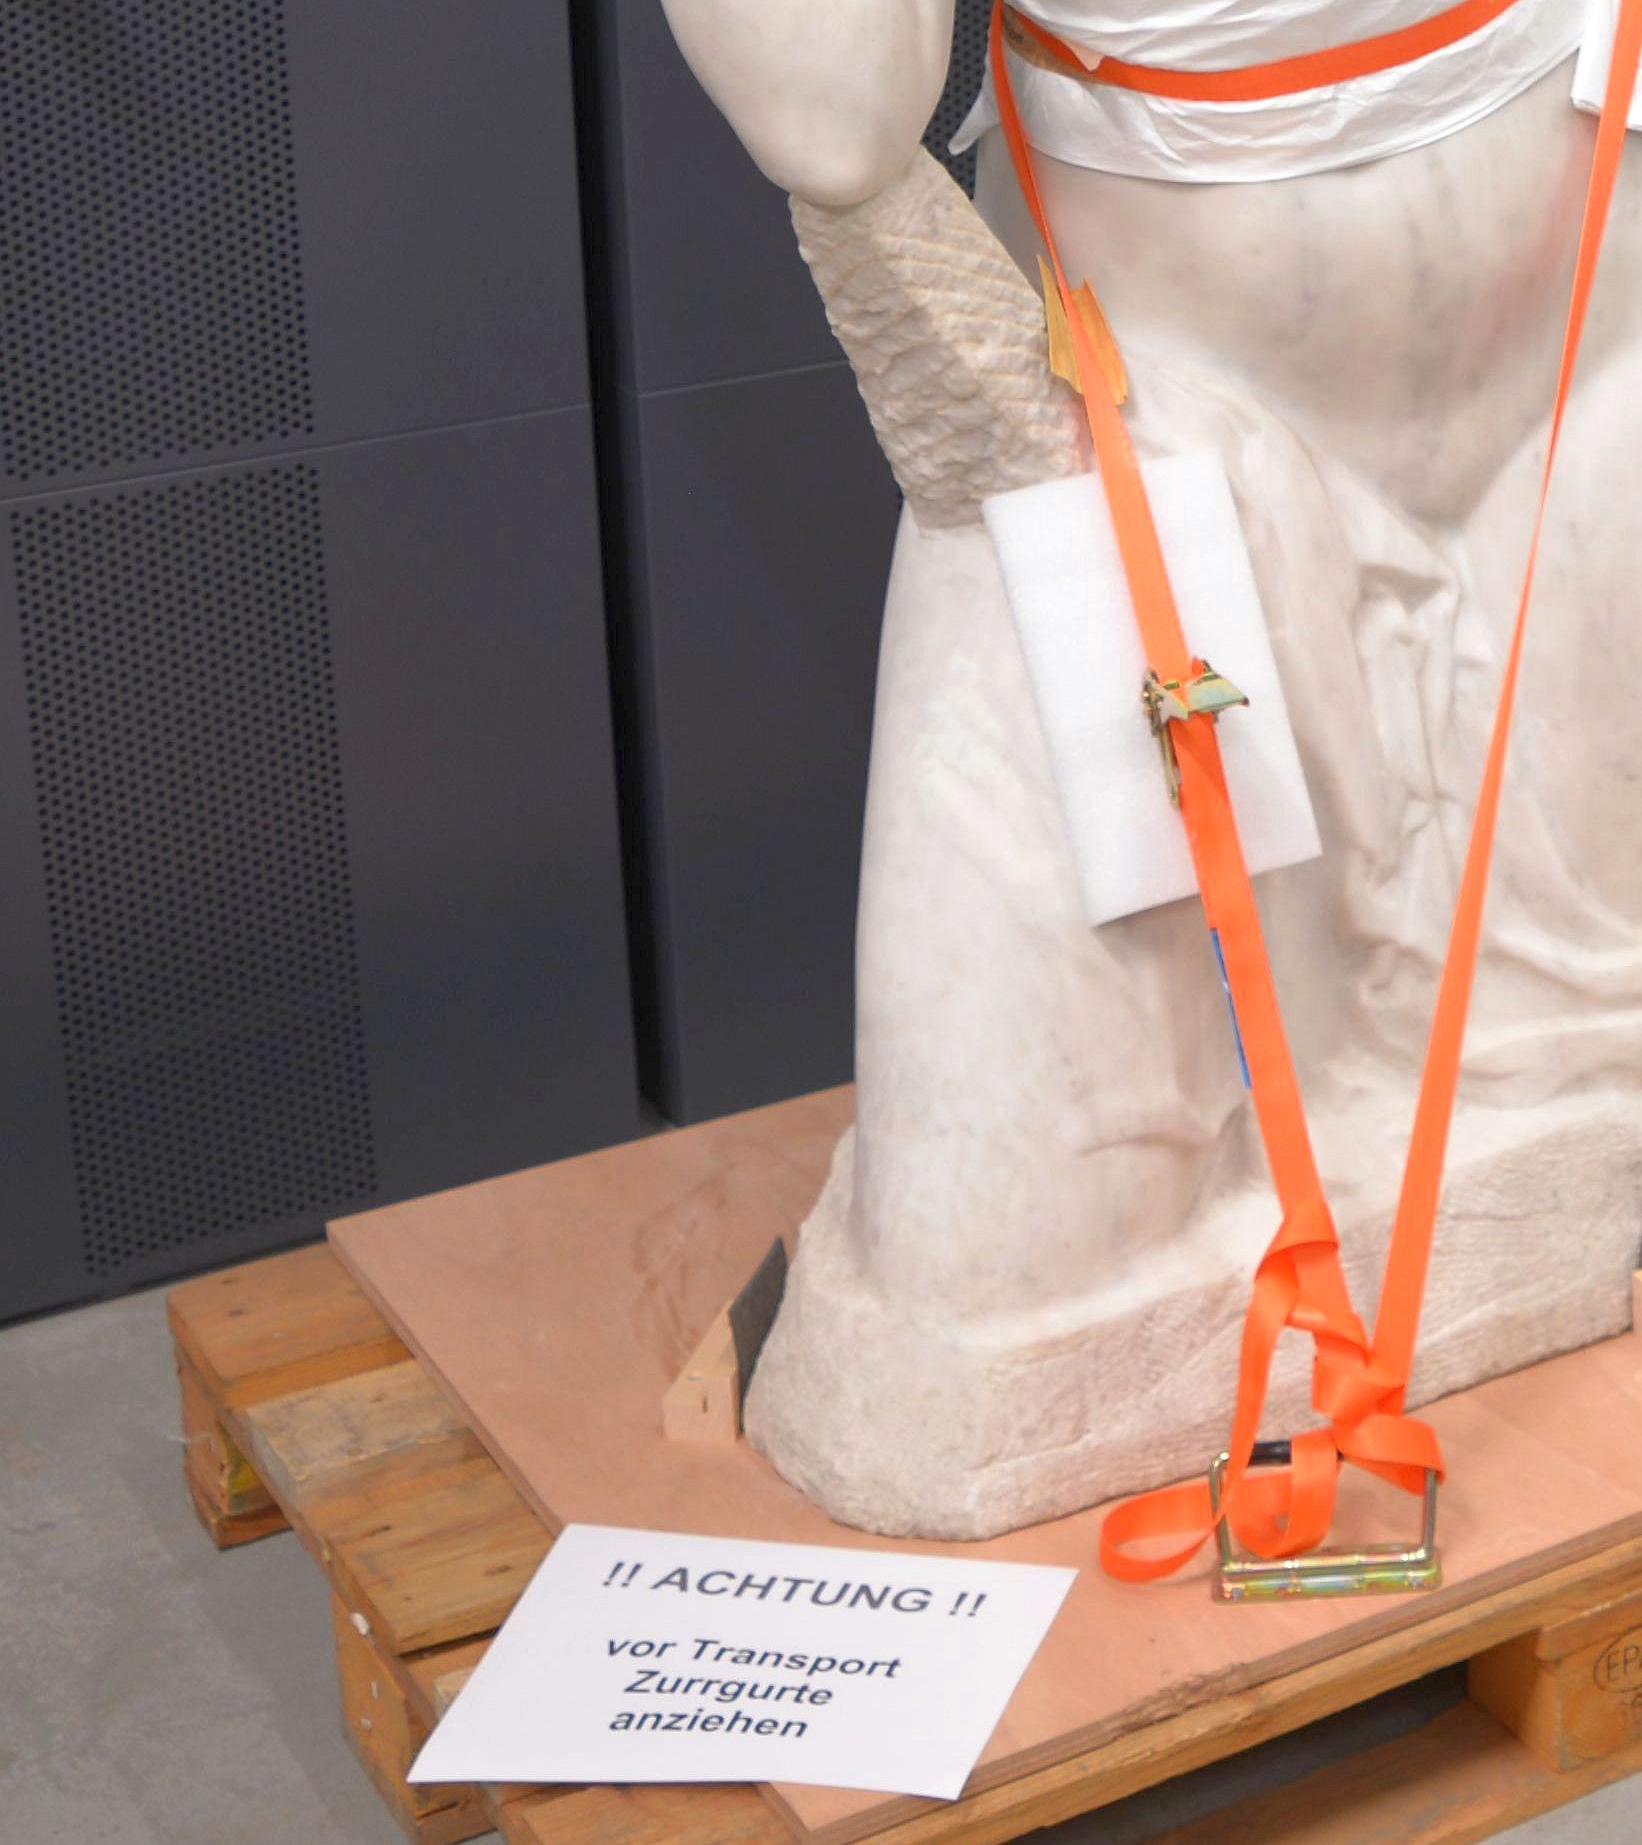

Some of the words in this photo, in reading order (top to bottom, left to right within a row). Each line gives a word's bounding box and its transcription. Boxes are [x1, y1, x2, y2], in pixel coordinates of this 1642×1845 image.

[651, 1566, 932, 1614] ACHTUNG
[606, 1638, 676, 1659] vor
[690, 1639, 902, 1680] Transport
[624, 1670, 834, 1706] Zurrgurte
[608, 1707, 808, 1739] anziehen
